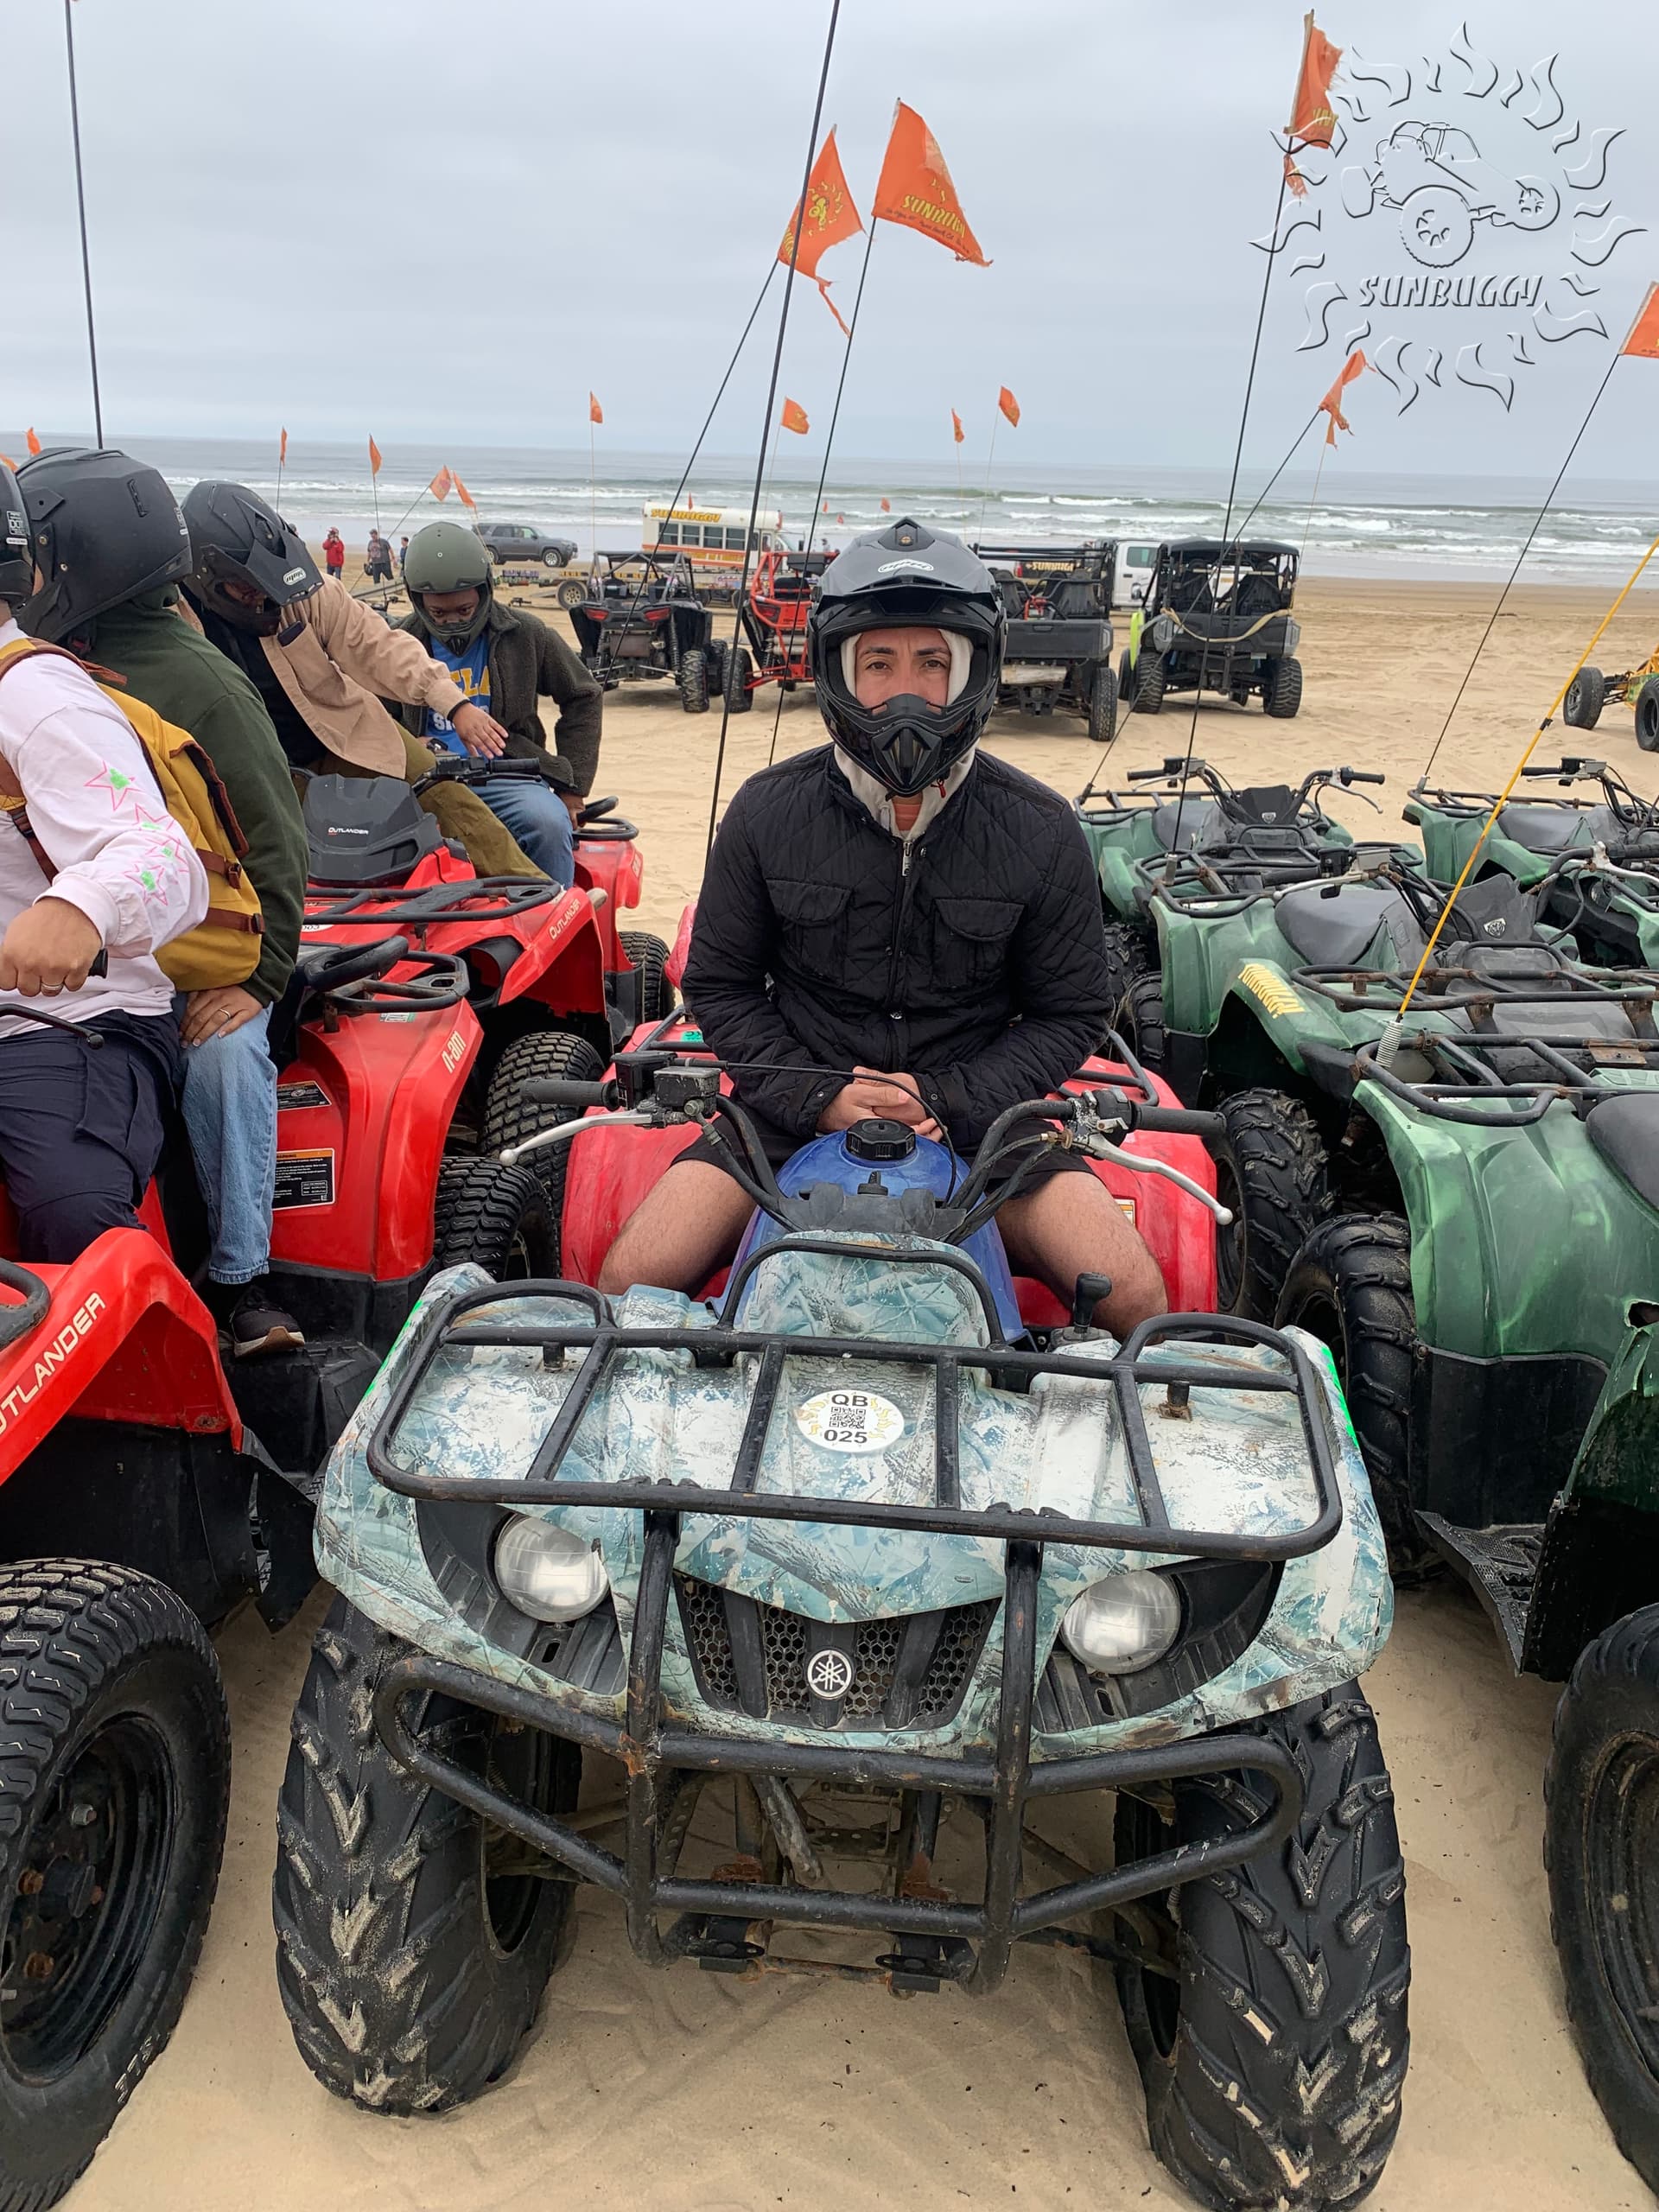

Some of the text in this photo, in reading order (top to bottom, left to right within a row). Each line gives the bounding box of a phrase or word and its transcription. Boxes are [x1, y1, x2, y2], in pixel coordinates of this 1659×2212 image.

[327, 827, 370, 836] OUTLANDER
[549, 898, 582, 940] OUTLANDER
[831, 1394, 868, 1407] QB
[823, 1429, 868, 1444] 025
